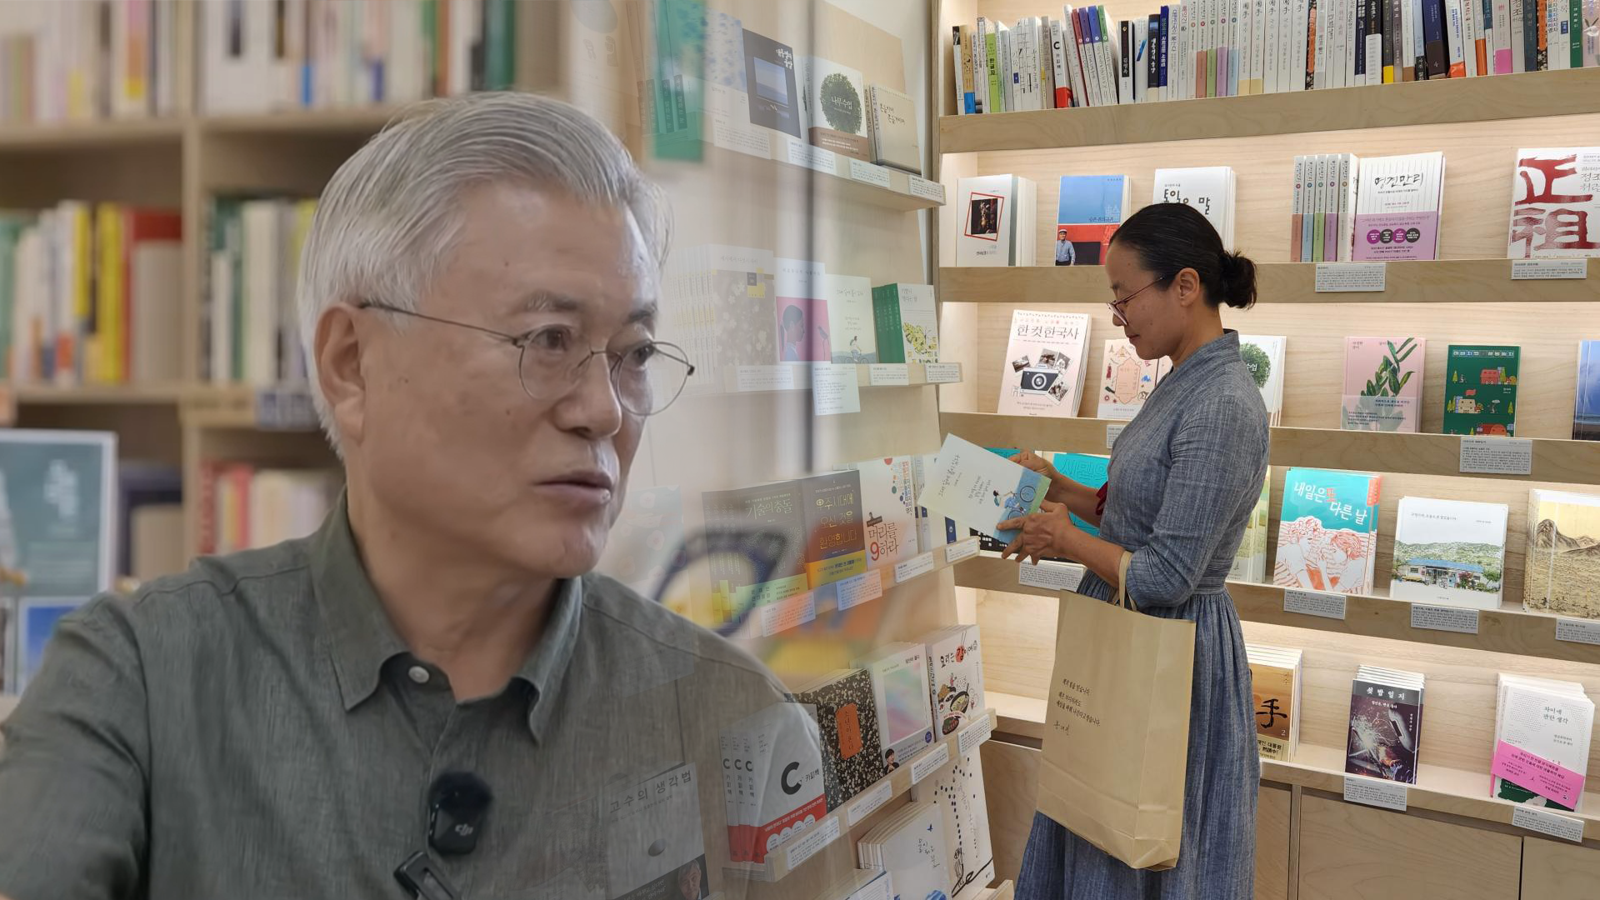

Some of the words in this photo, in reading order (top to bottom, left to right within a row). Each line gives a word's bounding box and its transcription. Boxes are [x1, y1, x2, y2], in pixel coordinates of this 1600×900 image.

[1374, 172, 1424, 189] 명견만리
[1017, 325, 1029, 336] 한
[1031, 326, 1043, 337] 컷
[1044, 326, 1079, 340] 한국사
[1293, 481, 1326, 503] 내일은
[1326, 487, 1336, 502] 또
[745, 501, 774, 519] 기술의
[774, 498, 793, 514] 충돌
[1329, 501, 1353, 520] 다른
[1355, 509, 1368, 525] 날
[820, 529, 858, 549] 환영합니다
[868, 522, 897, 542] 머리를
[1366, 686, 1405, 700] 쇳밥일지
[1544, 706, 1562, 715] 차이에
[1557, 717, 1569, 725] 생각
[723, 758, 731, 770] C
[734, 759, 742, 771] C
[745, 760, 753, 772] C
[781, 761, 802, 795] C
[610, 788, 649, 814] 고수의
[655, 770, 692, 794] 생각법
